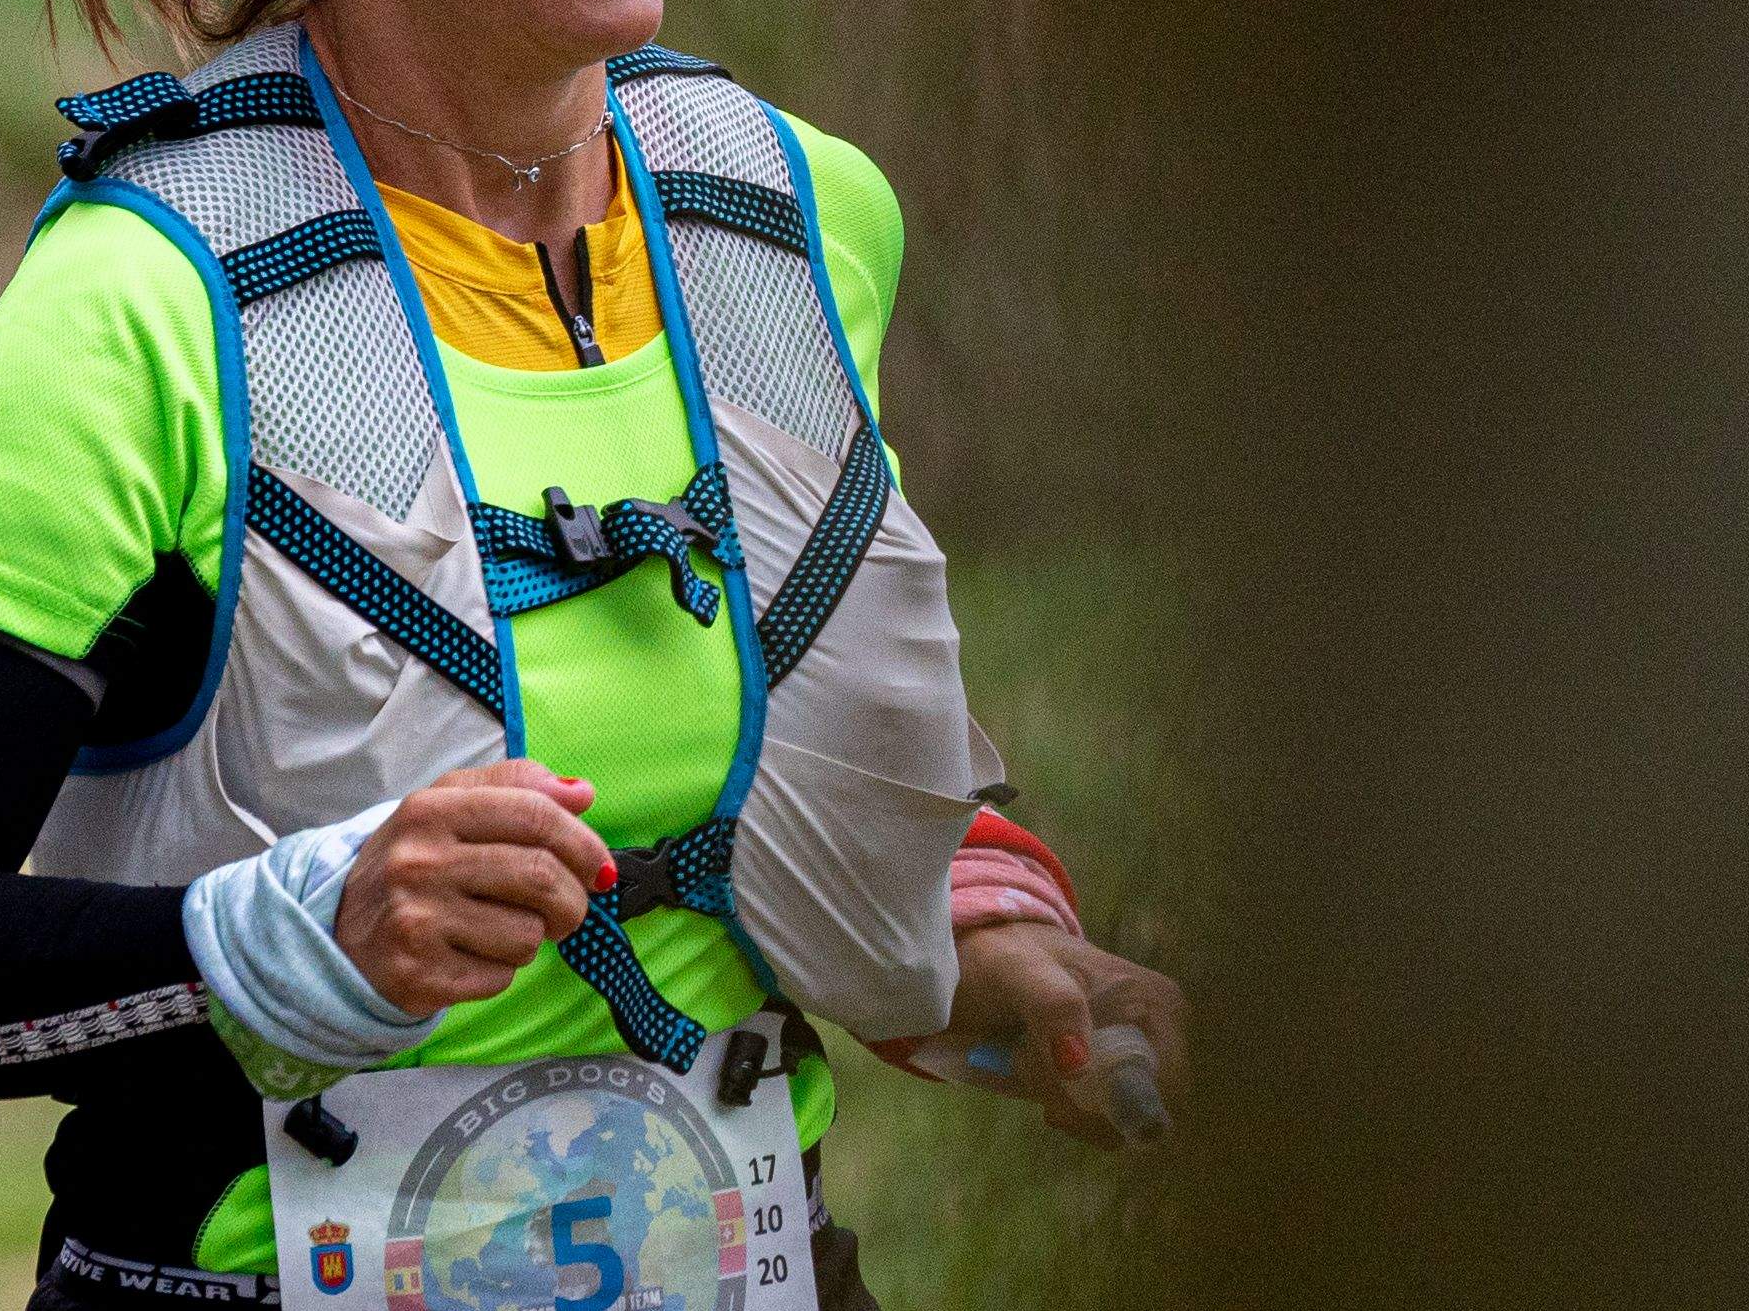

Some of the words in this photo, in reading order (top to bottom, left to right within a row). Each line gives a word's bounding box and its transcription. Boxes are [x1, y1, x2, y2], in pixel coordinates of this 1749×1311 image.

[453, 1076, 528, 1138] BIG
[549, 1064, 668, 1106] DOG'S
[748, 1154, 777, 1186] 17
[753, 1204, 783, 1236] 10
[119, 1272, 231, 1301] WEAR
[758, 1254, 789, 1287] 20
[630, 1289, 662, 1310] TEAM
